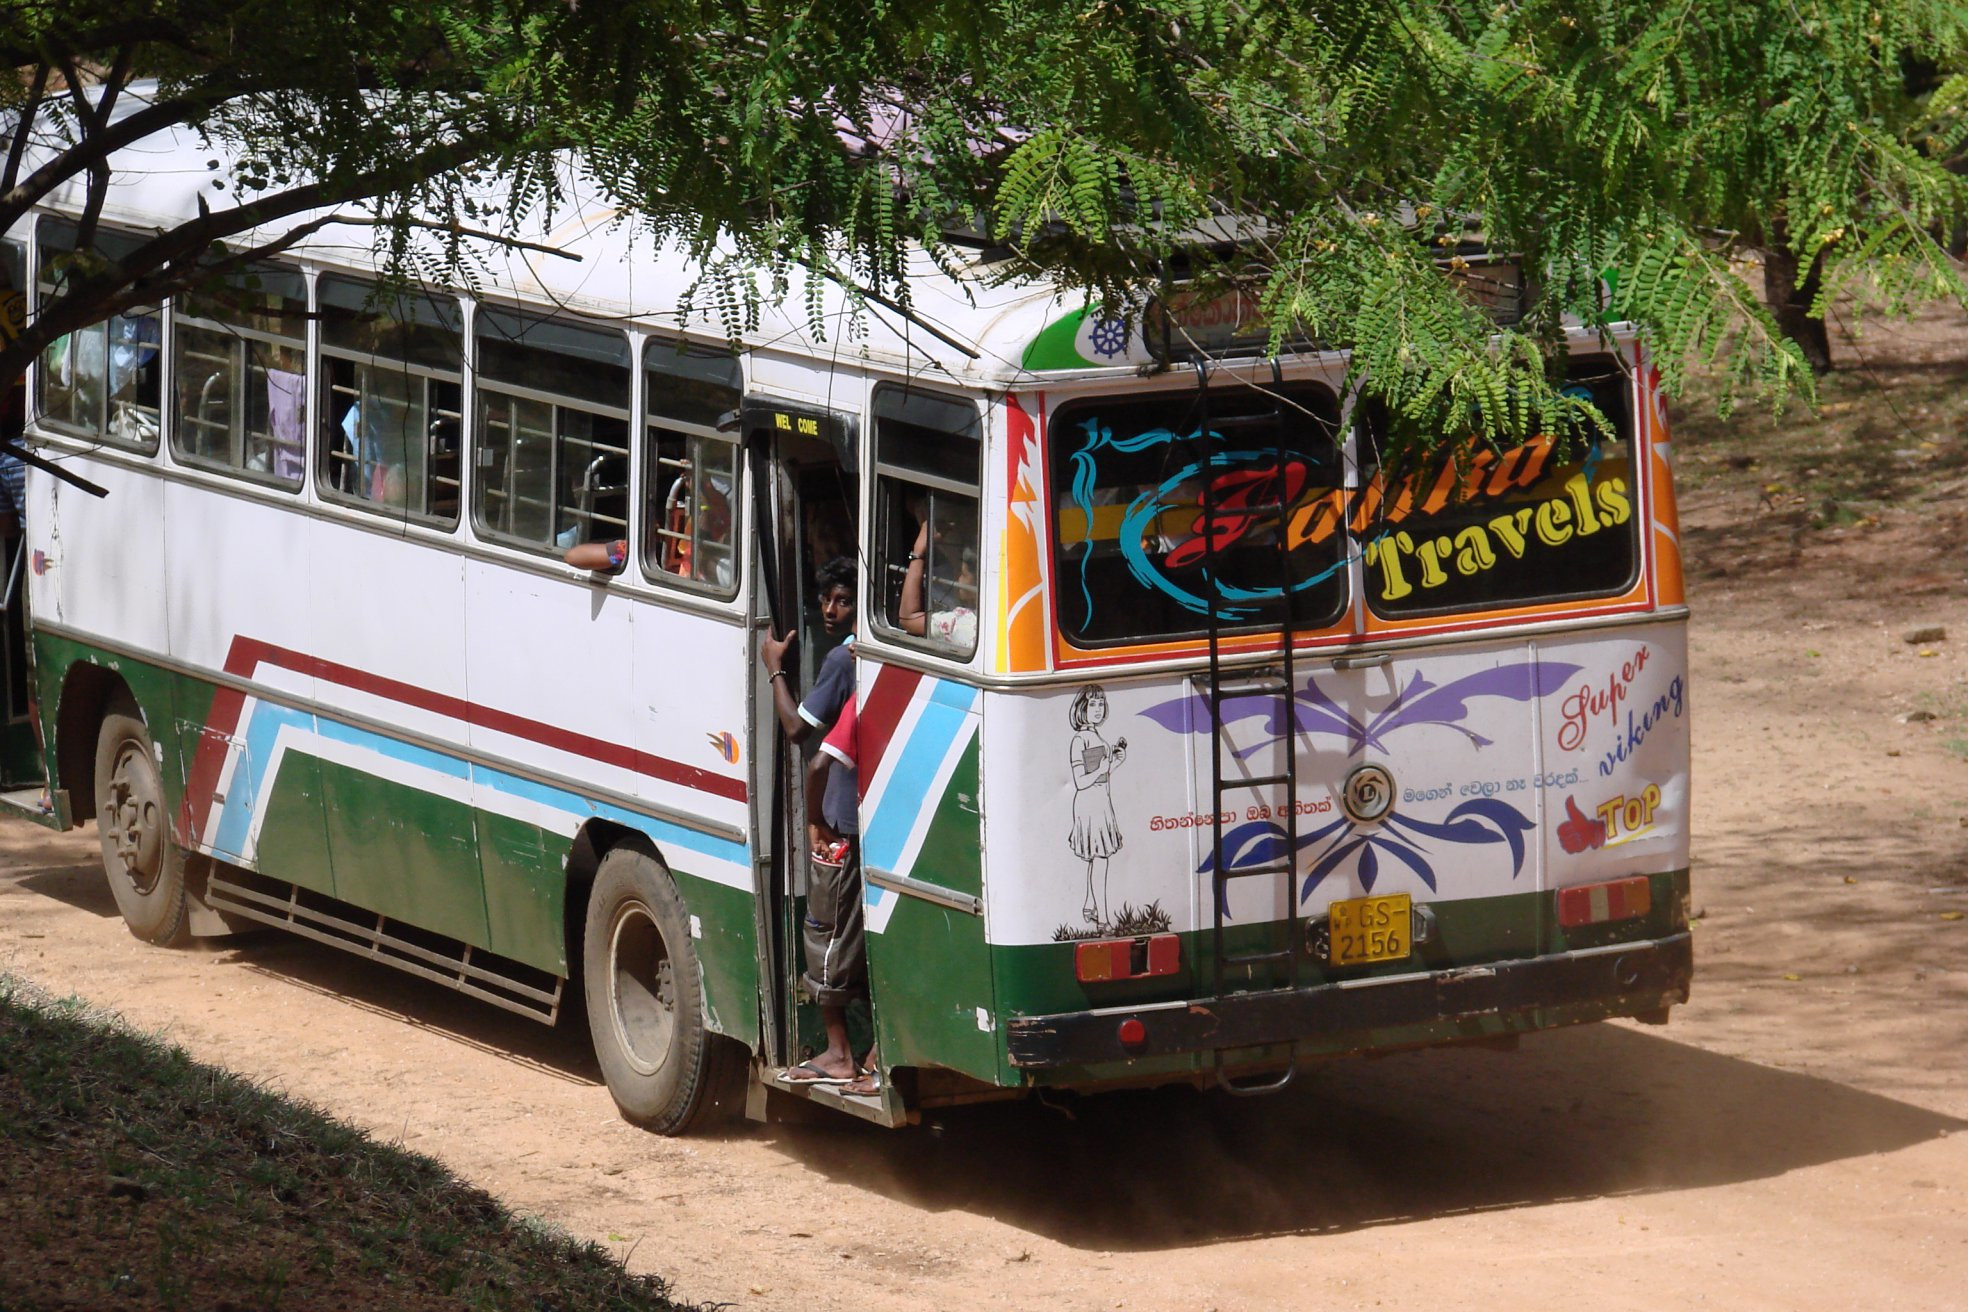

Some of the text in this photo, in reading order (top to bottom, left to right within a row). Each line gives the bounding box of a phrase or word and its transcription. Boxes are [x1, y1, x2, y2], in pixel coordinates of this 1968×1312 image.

[775, 412, 819, 436] WEL COME
[1365, 472, 1631, 600] Travels
[1557, 643, 1650, 752] Super
[1599, 674, 1684, 777] viking
[1596, 782, 1662, 840] TOP
[1340, 929, 1400, 961] 2156
